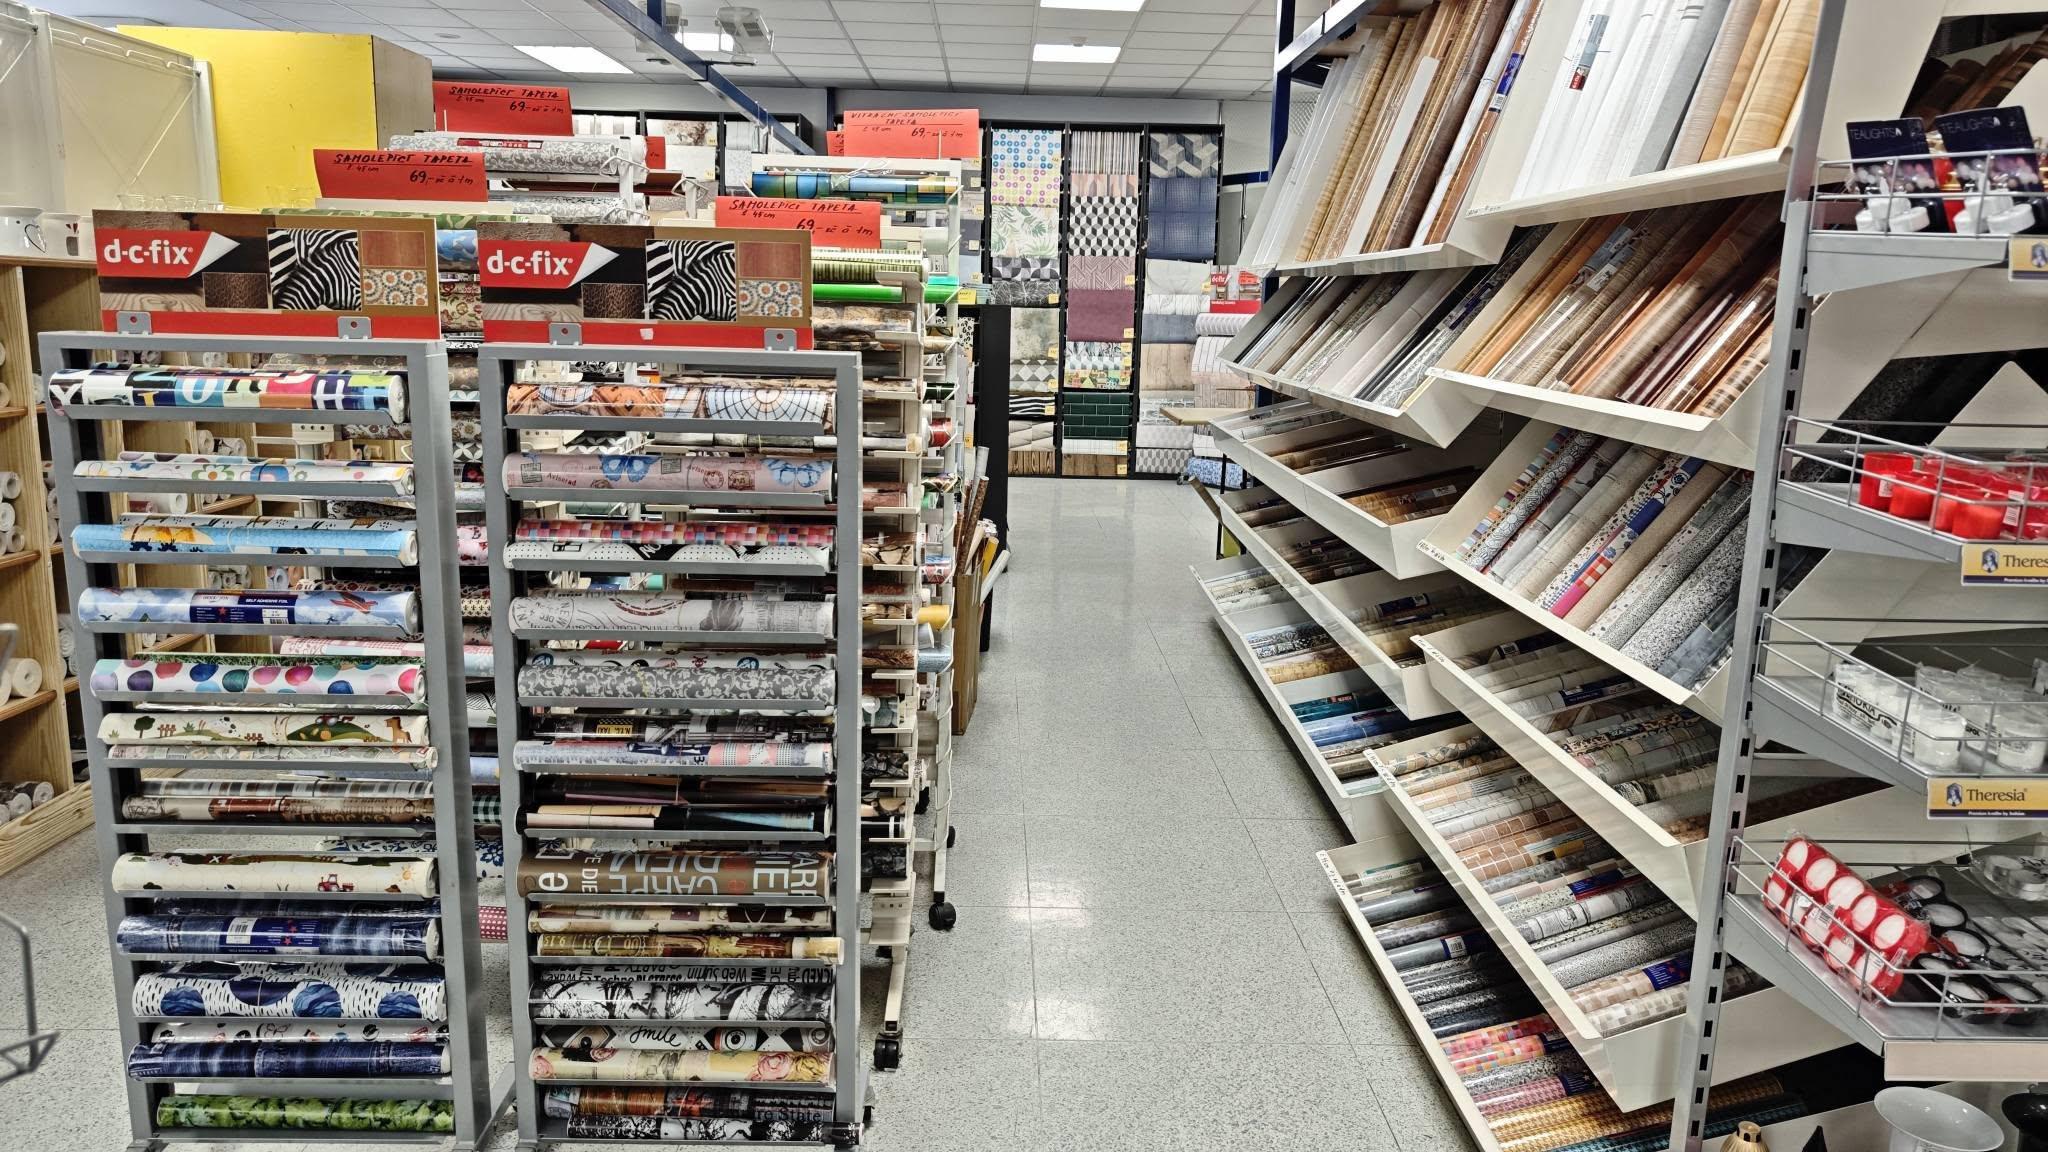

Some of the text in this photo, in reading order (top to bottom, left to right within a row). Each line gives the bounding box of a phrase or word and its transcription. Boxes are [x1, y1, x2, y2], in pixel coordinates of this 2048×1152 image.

[521, 88, 560, 99] TAPETA
[1850, 127, 1897, 140] TEALIGHTS
[423, 154, 473, 164] TAPETA
[811, 202, 858, 212] TAPETA
[1966, 788, 2025, 802] Theresia
